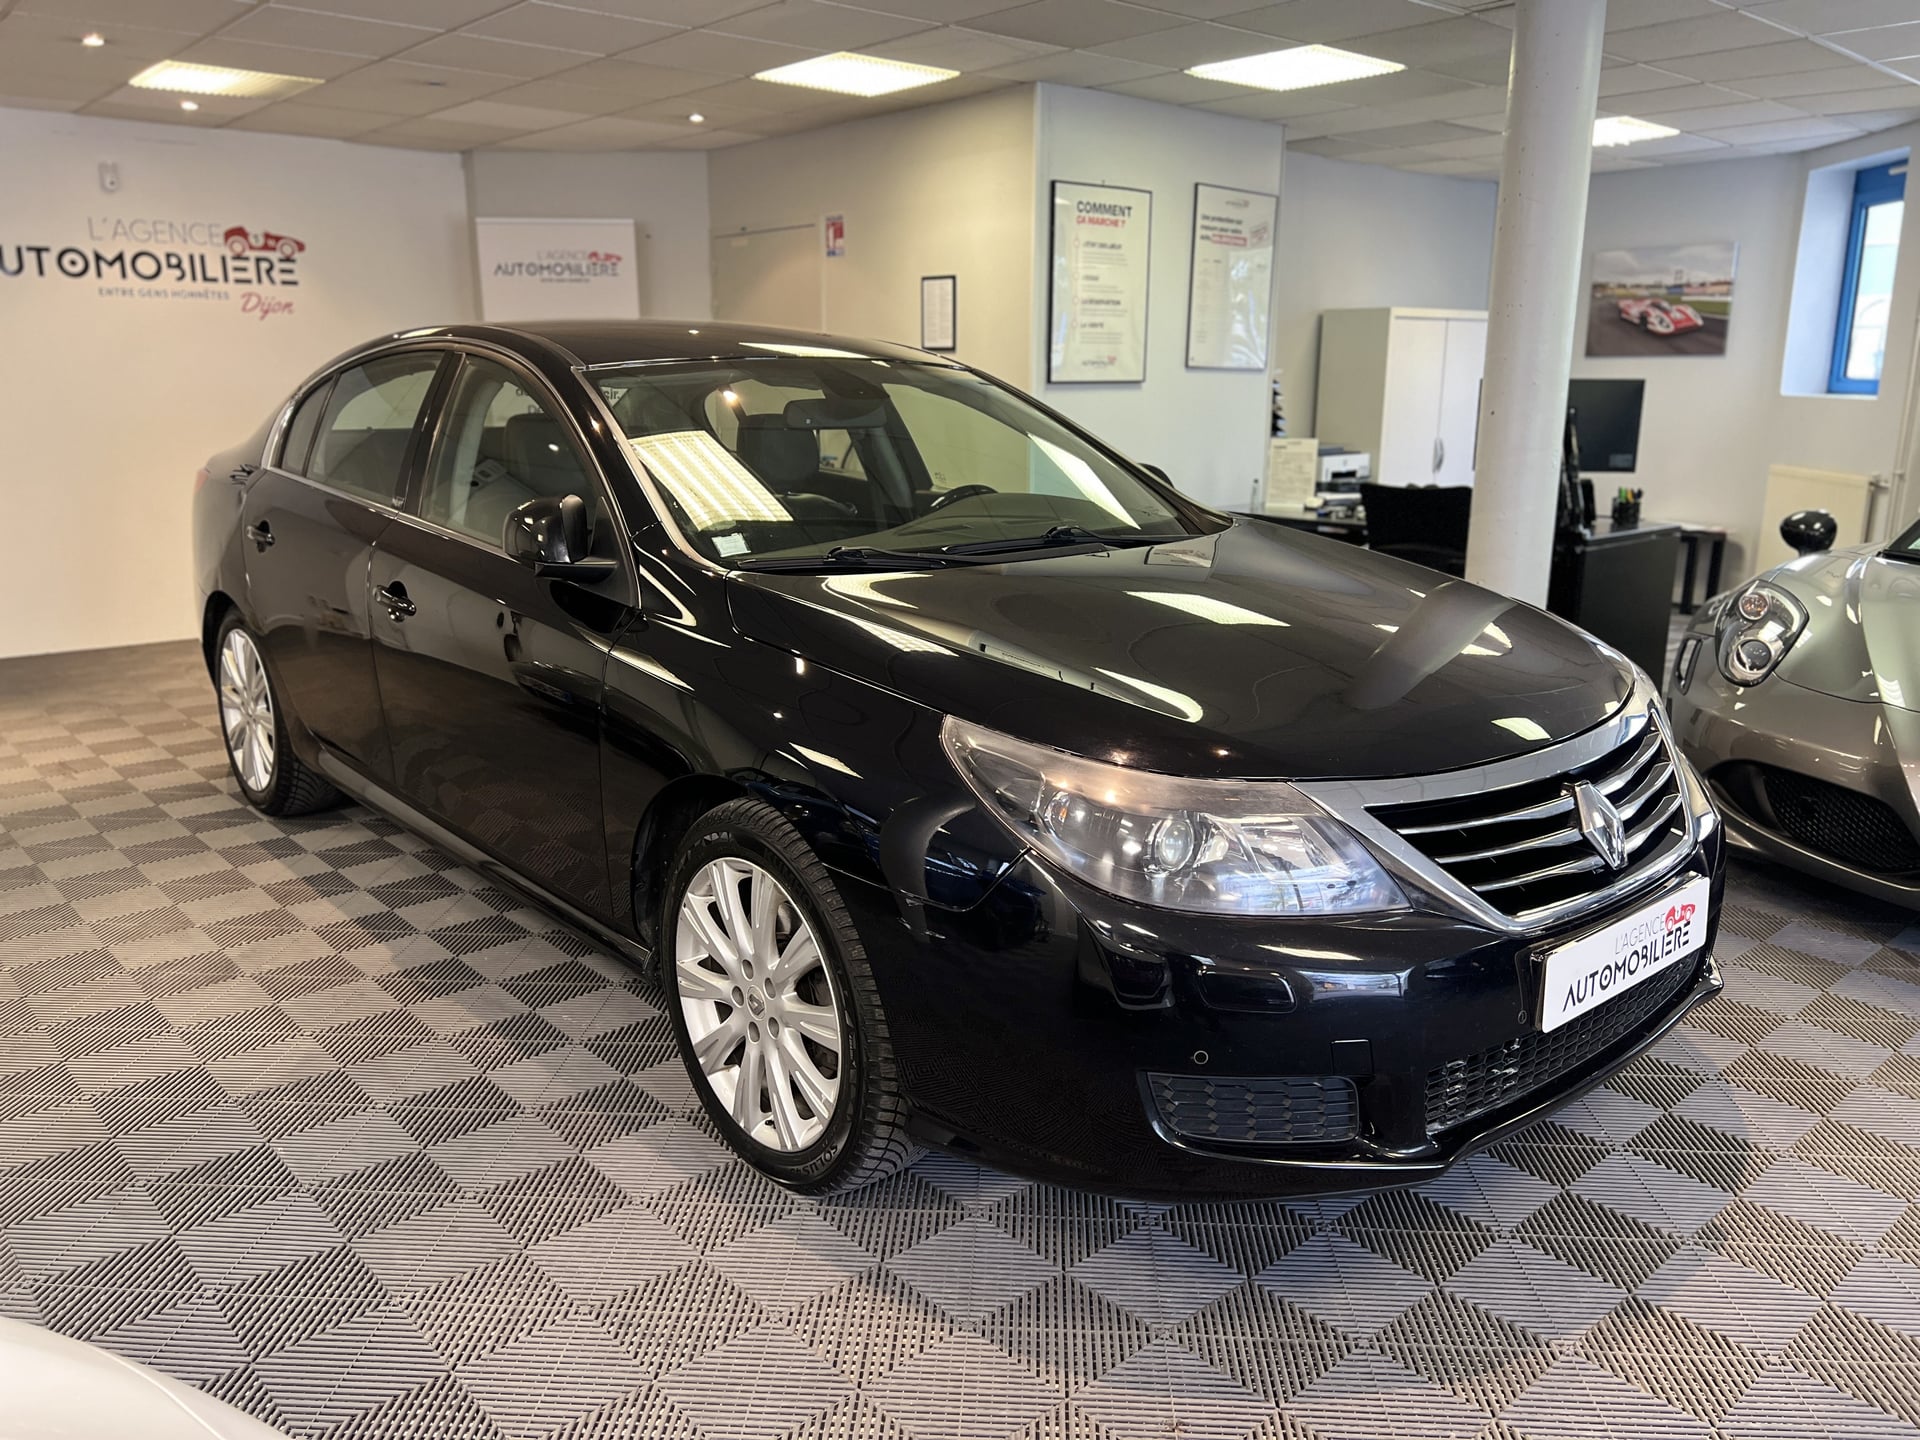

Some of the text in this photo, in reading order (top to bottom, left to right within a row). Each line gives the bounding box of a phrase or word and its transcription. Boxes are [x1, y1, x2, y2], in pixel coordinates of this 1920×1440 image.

[1076, 200, 1133, 218] COMMENT
[1088, 216, 1119, 228] MARCHE
[87, 216, 224, 248] L'AGENCE
[98, 287, 135, 298] ENTRE
[138, 288, 169, 299] GENS
[240, 291, 295, 321] Dijon
[1615, 912, 1666, 955] L'AGENCE
[802, 1143, 838, 1176] SOLUS
